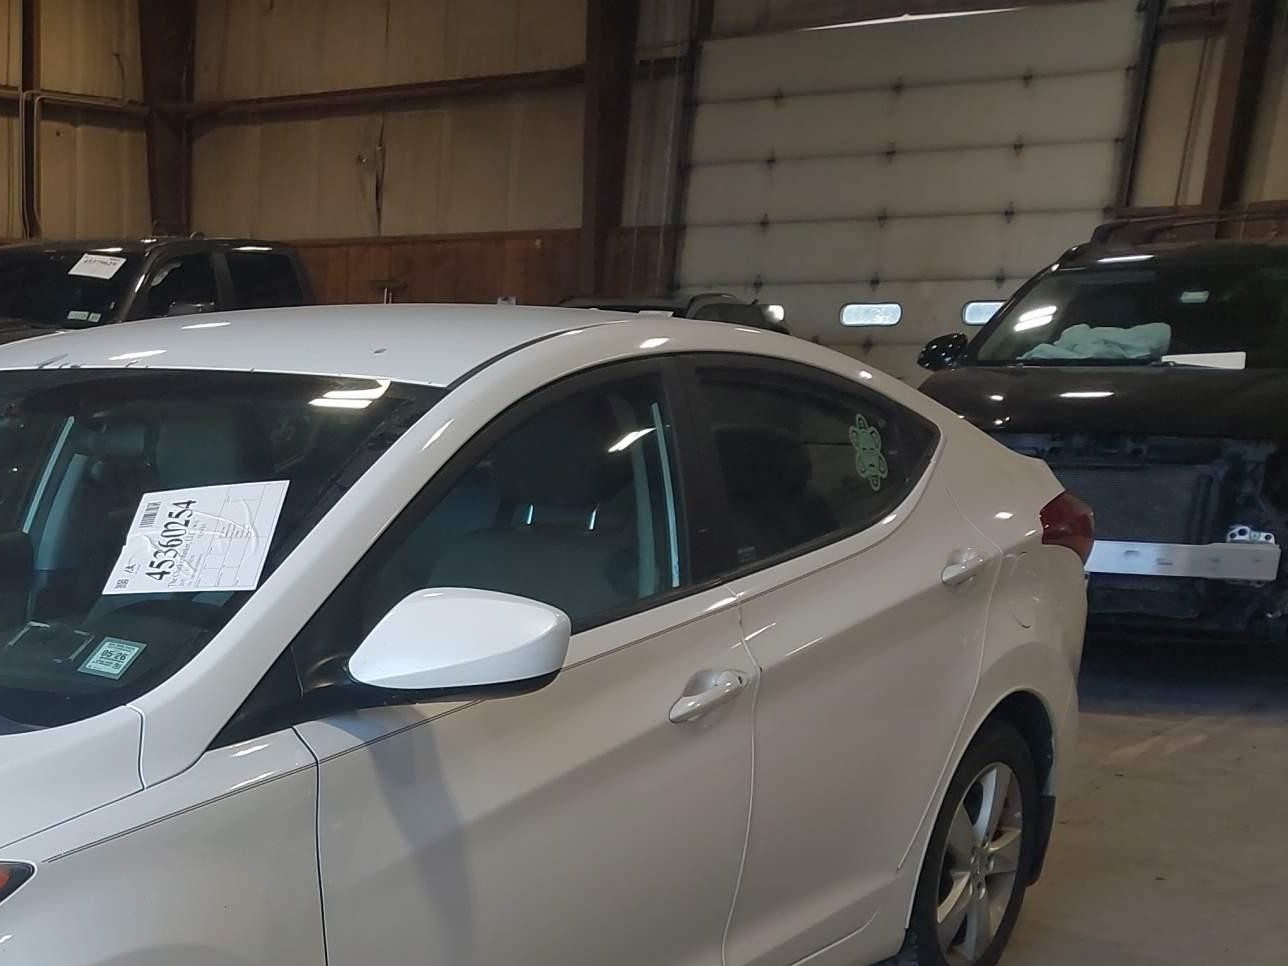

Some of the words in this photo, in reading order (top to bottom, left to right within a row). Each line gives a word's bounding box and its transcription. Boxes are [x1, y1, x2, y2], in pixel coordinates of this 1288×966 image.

[144, 499, 198, 581] 45360254
[101, 649, 114, 658] 05
[114, 652, 128, 661] 26
